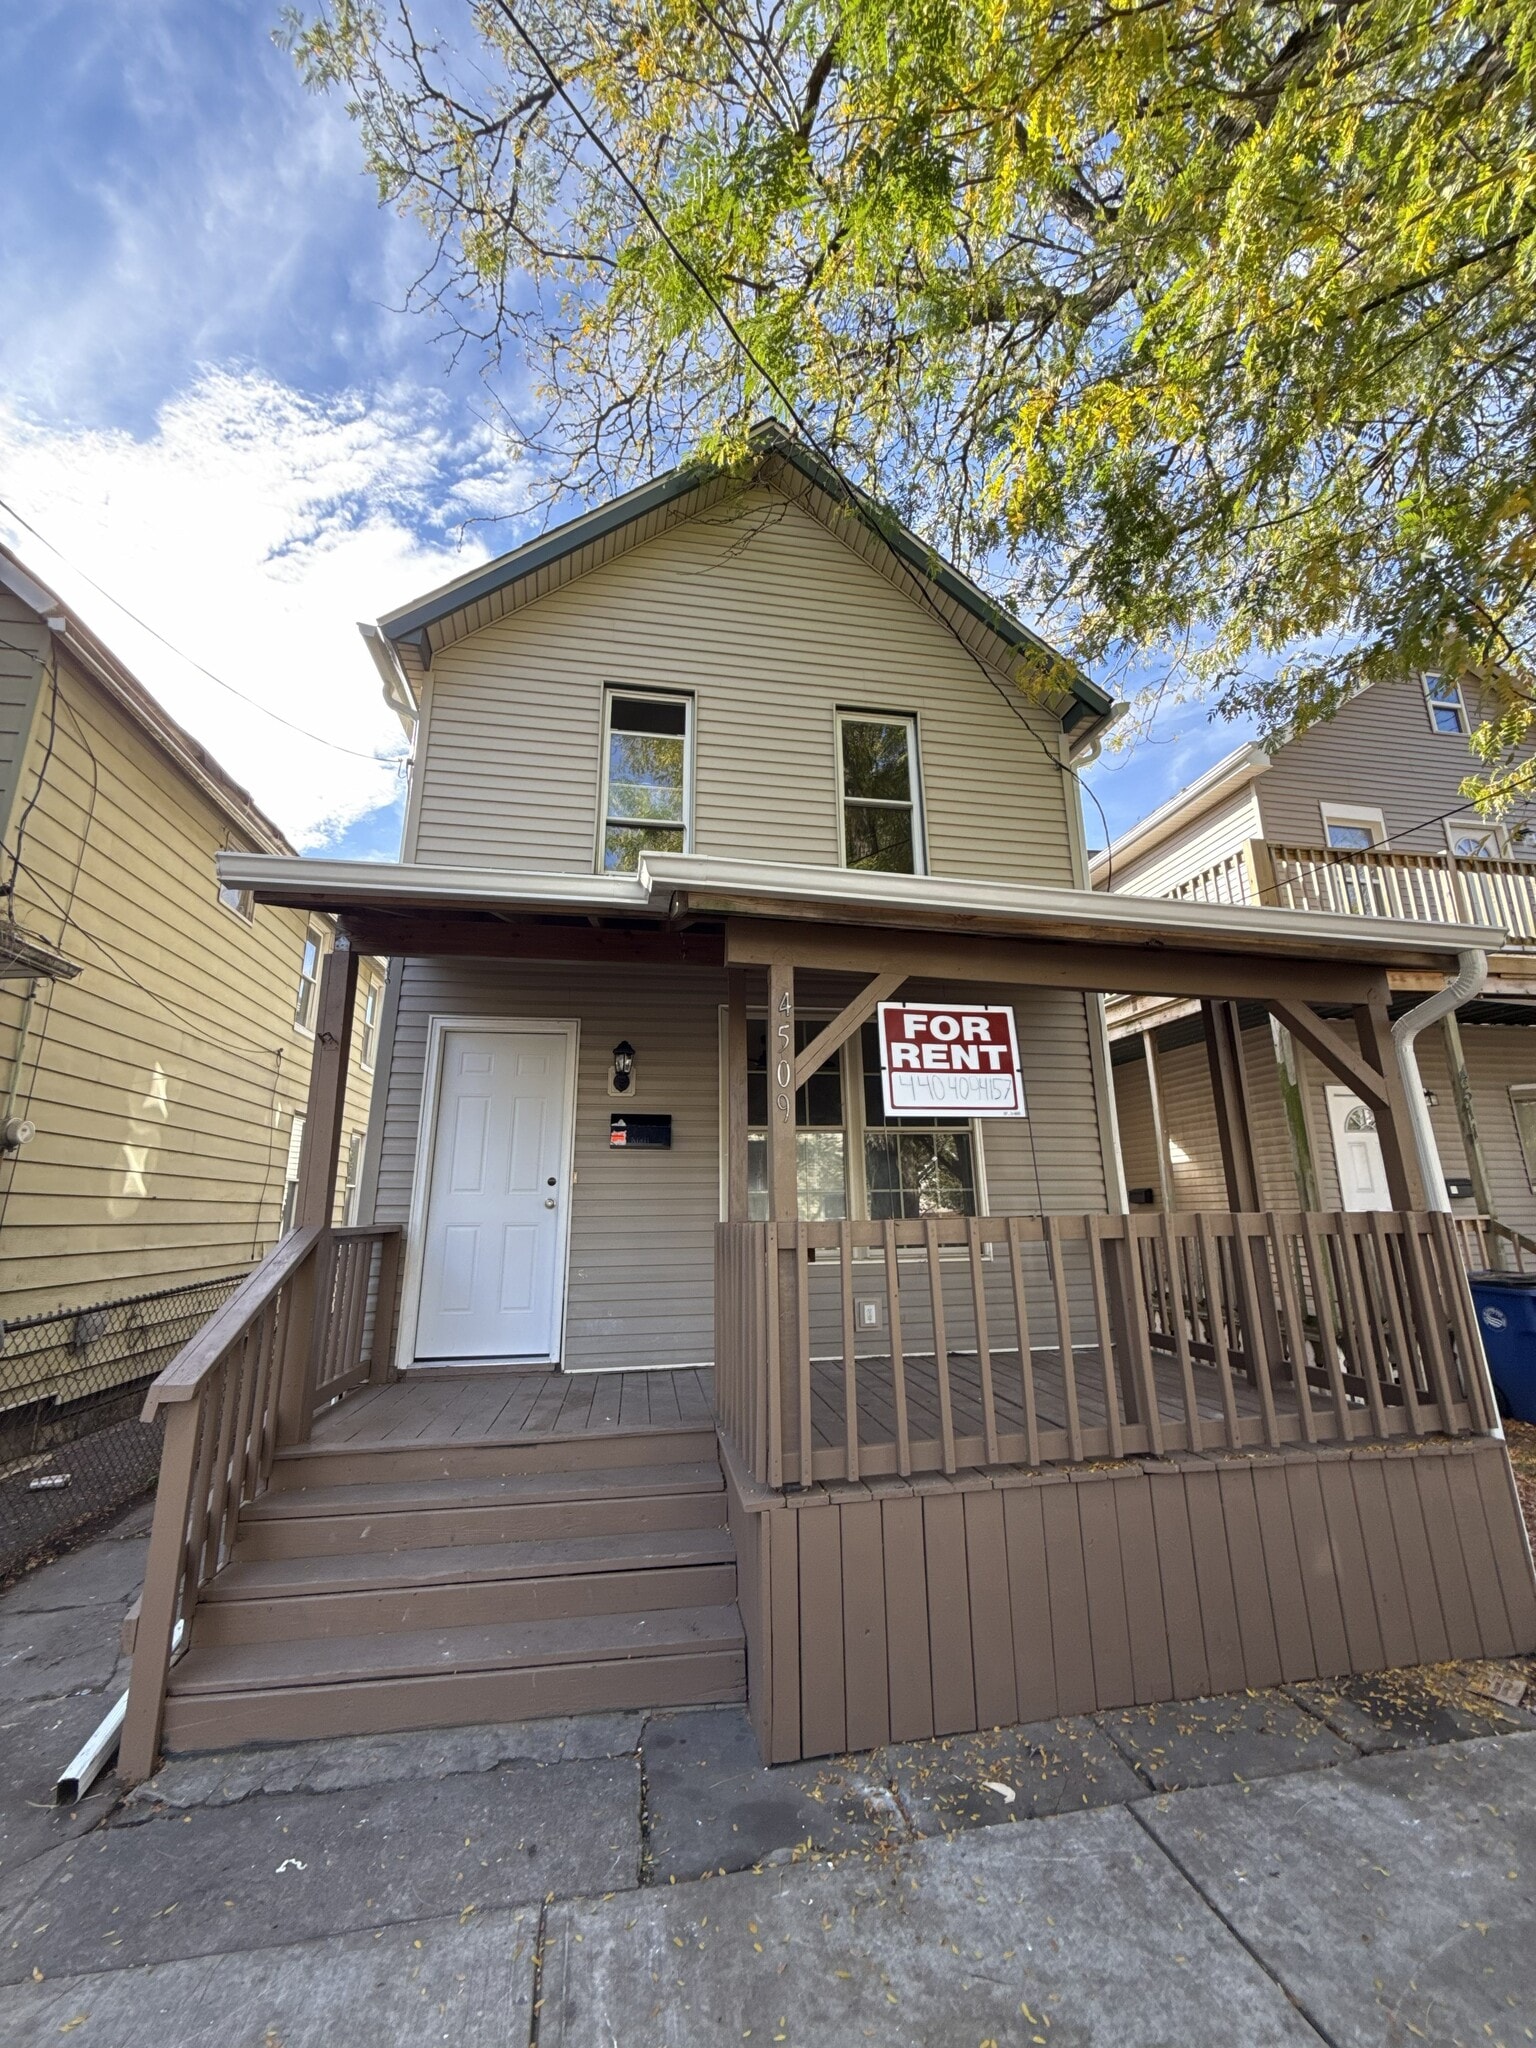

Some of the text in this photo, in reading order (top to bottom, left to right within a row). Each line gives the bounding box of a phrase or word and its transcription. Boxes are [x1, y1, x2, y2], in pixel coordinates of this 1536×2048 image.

[903, 1013, 992, 1042] FOR
[777, 991, 792, 1124] 4509
[890, 1042, 1008, 1070] RENT
